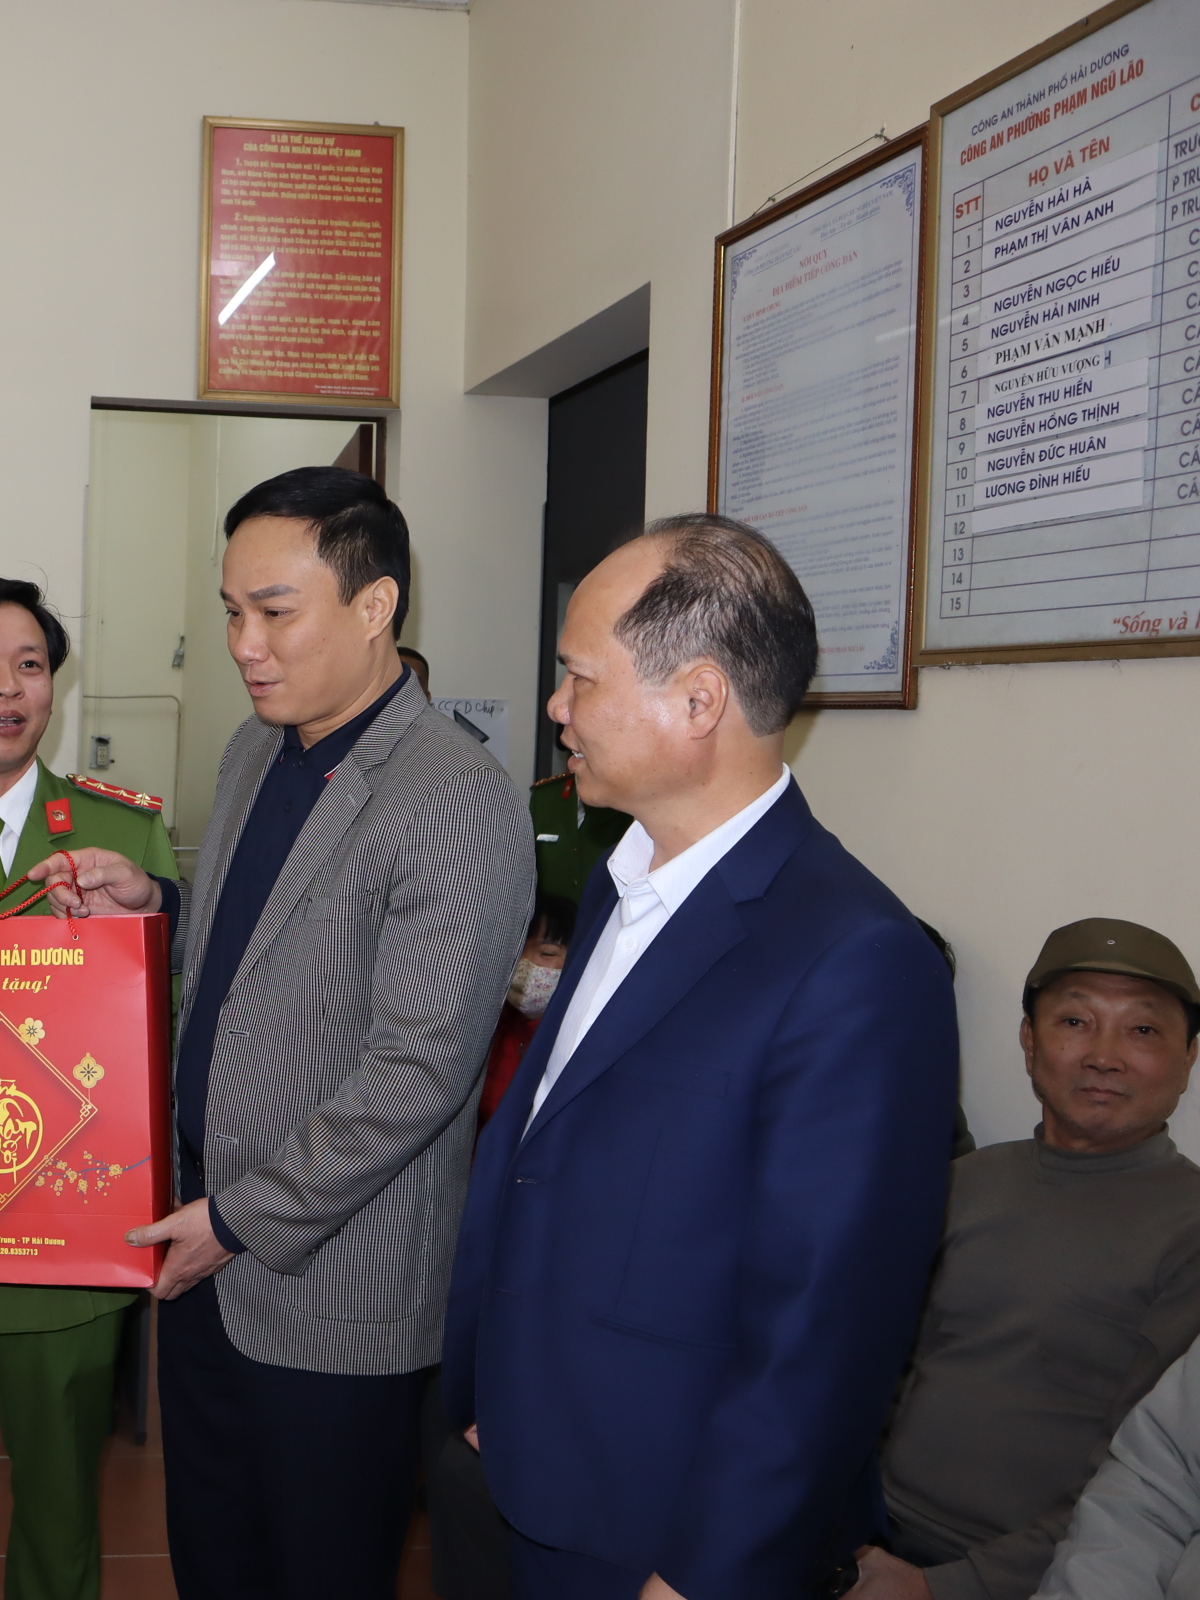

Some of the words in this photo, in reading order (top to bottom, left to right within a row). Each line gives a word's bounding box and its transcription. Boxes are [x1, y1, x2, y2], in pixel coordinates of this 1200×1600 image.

[971, 112, 998, 136] CÔNG
[1000, 105, 1014, 122] AN
[1016, 89, 1046, 113] THÀNH
[1048, 74, 1068, 96] PHỐ
[1070, 64, 1088, 88] HẢI
[1090, 44, 1130, 74] DƯƠNG
[960, 138, 987, 166] CÔNG
[990, 132, 1004, 152] AN
[1006, 108, 1050, 143] PHƯỜNG
[1053, 87, 1088, 120] PHẠM
[1090, 72, 1116, 101] NGŨ
[1120, 58, 1144, 86] LÃO
[1028, 166, 1049, 188] HỌ
[1054, 152, 1075, 176] VÀ
[1079, 136, 1111, 164] TÊN
[955, 194, 982, 219] STT
[966, 235, 971, 248] 1
[995, 198, 1044, 232] NGUYỄN
[1048, 186, 1069, 210] HẢI
[1072, 176, 1092, 198] HÀ
[964, 260, 971, 274] 2
[994, 234, 1029, 259] PHẠM
[1031, 224, 1049, 246] THỊ
[1052, 214, 1080, 237] VÂN
[1084, 200, 1114, 225] ANH
[962, 313, 970, 326] 4
[993, 284, 1042, 314] NGUYỄN
[1046, 268, 1088, 296] NGỌC
[1090, 255, 1121, 280] HIẾU
[963, 284, 970, 298] 3
[962, 338, 969, 352] 5
[990, 310, 1039, 340] NGUYỄN
[1042, 301, 1064, 324] HẢI
[1068, 292, 1100, 315] NINH
[960, 366, 968, 380] 6
[995, 342, 1031, 365] PHẠM
[1035, 330, 1061, 352] VĂN
[1064, 317, 1106, 344] MẠNH
[959, 418, 966, 431] 8
[986, 392, 1035, 419] NGUYỄN
[1038, 388, 1060, 404] THU
[1063, 378, 1093, 399] HIỀN
[960, 390, 968, 404] 7
[958, 441, 966, 455] 9
[987, 420, 1035, 445] NGUYỄN
[1038, 410, 1078, 432] HỒNG
[1081, 401, 1120, 424] THỊNH
[956, 466, 968, 480] 10
[987, 448, 1035, 472] NGUYỄN
[1038, 442, 1066, 462] ĐỨC
[1069, 436, 1106, 456] HUÂN
[956, 493, 967, 508] 11
[985, 480, 1026, 498] LƯƠNG
[1029, 474, 1060, 492] ĐÌNH
[1062, 466, 1091, 485] HIẾU
[954, 520, 966, 536] 12
[952, 547, 964, 562] 13
[951, 572, 963, 586] 14
[950, 597, 962, 612] 15
[1168, 610, 1188, 630] và
[0, 944, 26, 966] HẢI
[30, 947, 84, 966] DƯƠNG
[2, 975, 51, 994] tặng!
[22, 1236, 30, 1244] TP
[32, 1236, 42, 1244] Hải
[44, 1237, 66, 1246] Dương
